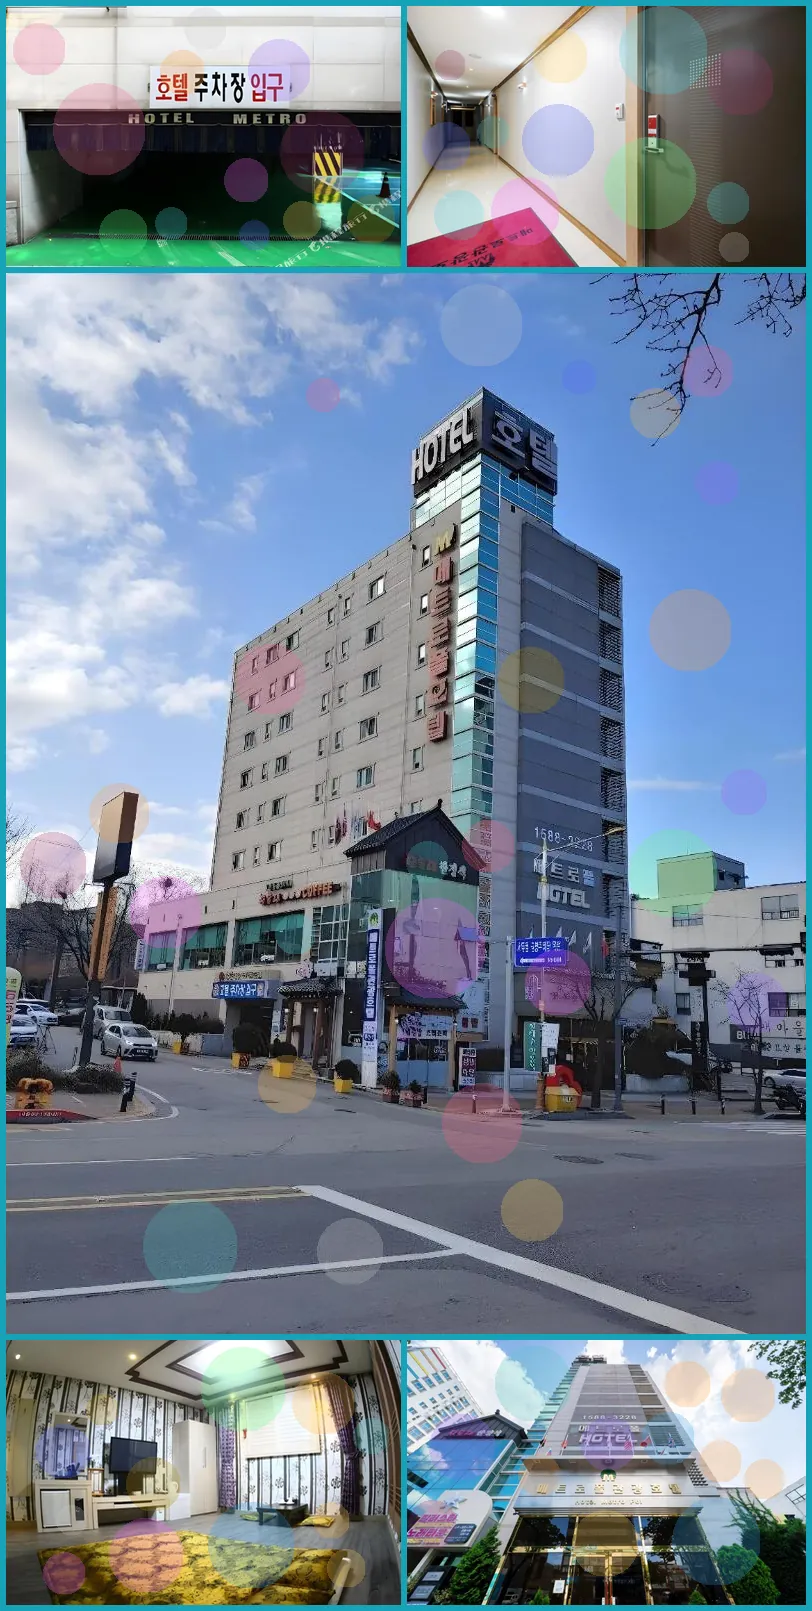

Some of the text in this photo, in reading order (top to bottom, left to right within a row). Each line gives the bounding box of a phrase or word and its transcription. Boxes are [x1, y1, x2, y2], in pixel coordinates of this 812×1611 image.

[155, 72, 285, 103] 호텔 주차장 입구
[128, 112, 308, 125] HOTEL METRO
[411, 406, 475, 486] HOTEL
[491, 410, 559, 481] 호텔
[302, 881, 333, 899] COFFEE
[578, 1433, 638, 1444] HOTEL
